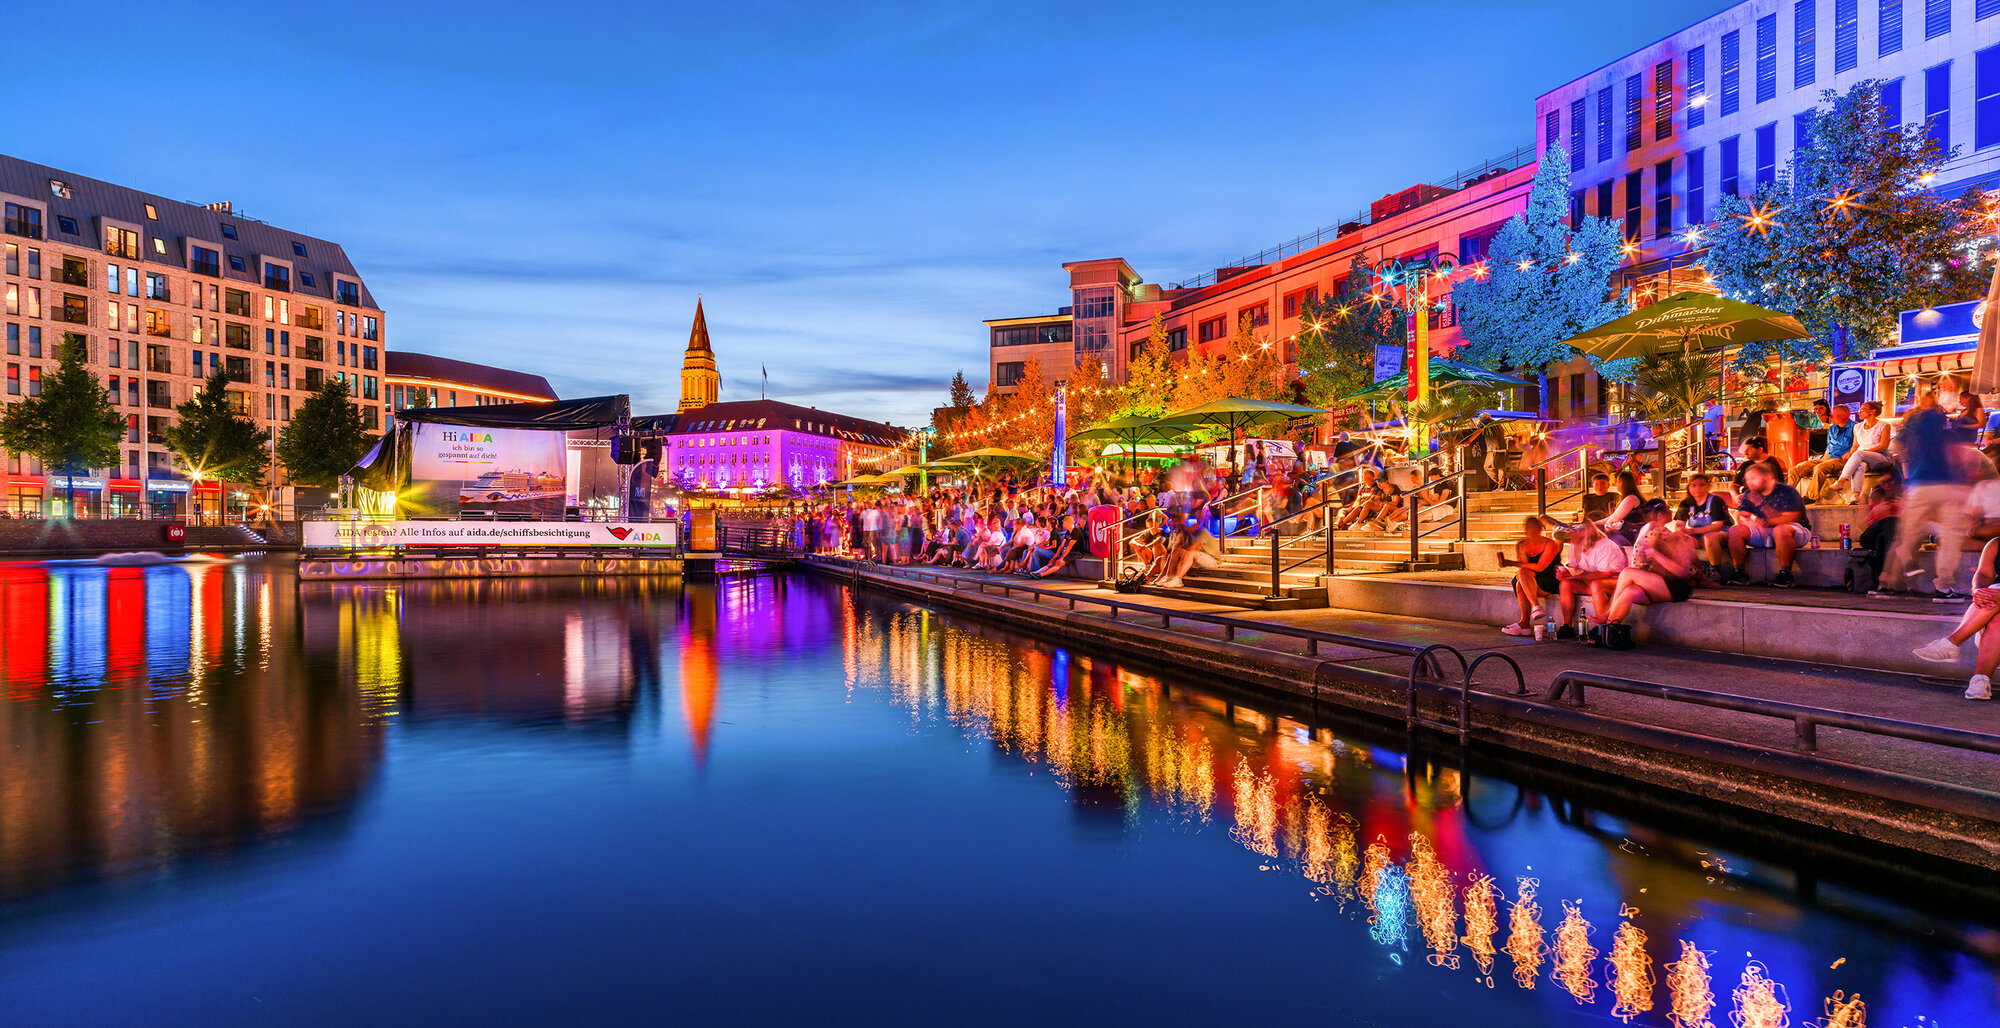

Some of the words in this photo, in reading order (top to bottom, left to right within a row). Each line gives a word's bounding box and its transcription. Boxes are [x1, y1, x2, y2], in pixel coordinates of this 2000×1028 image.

[1635, 306, 1724, 330] Dithmarscher
[443, 431, 457, 442] Hi
[460, 433, 493, 443] AIDA
[334, 528, 361, 537] AIDA
[363, 528, 397, 537] testen?
[400, 528, 419, 537] Alle
[422, 528, 446, 537] Infos
[448, 528, 465, 537] auf
[466, 528, 591, 539] aida.de/schiffsbesichtigung
[632, 532, 662, 542] AIDA
